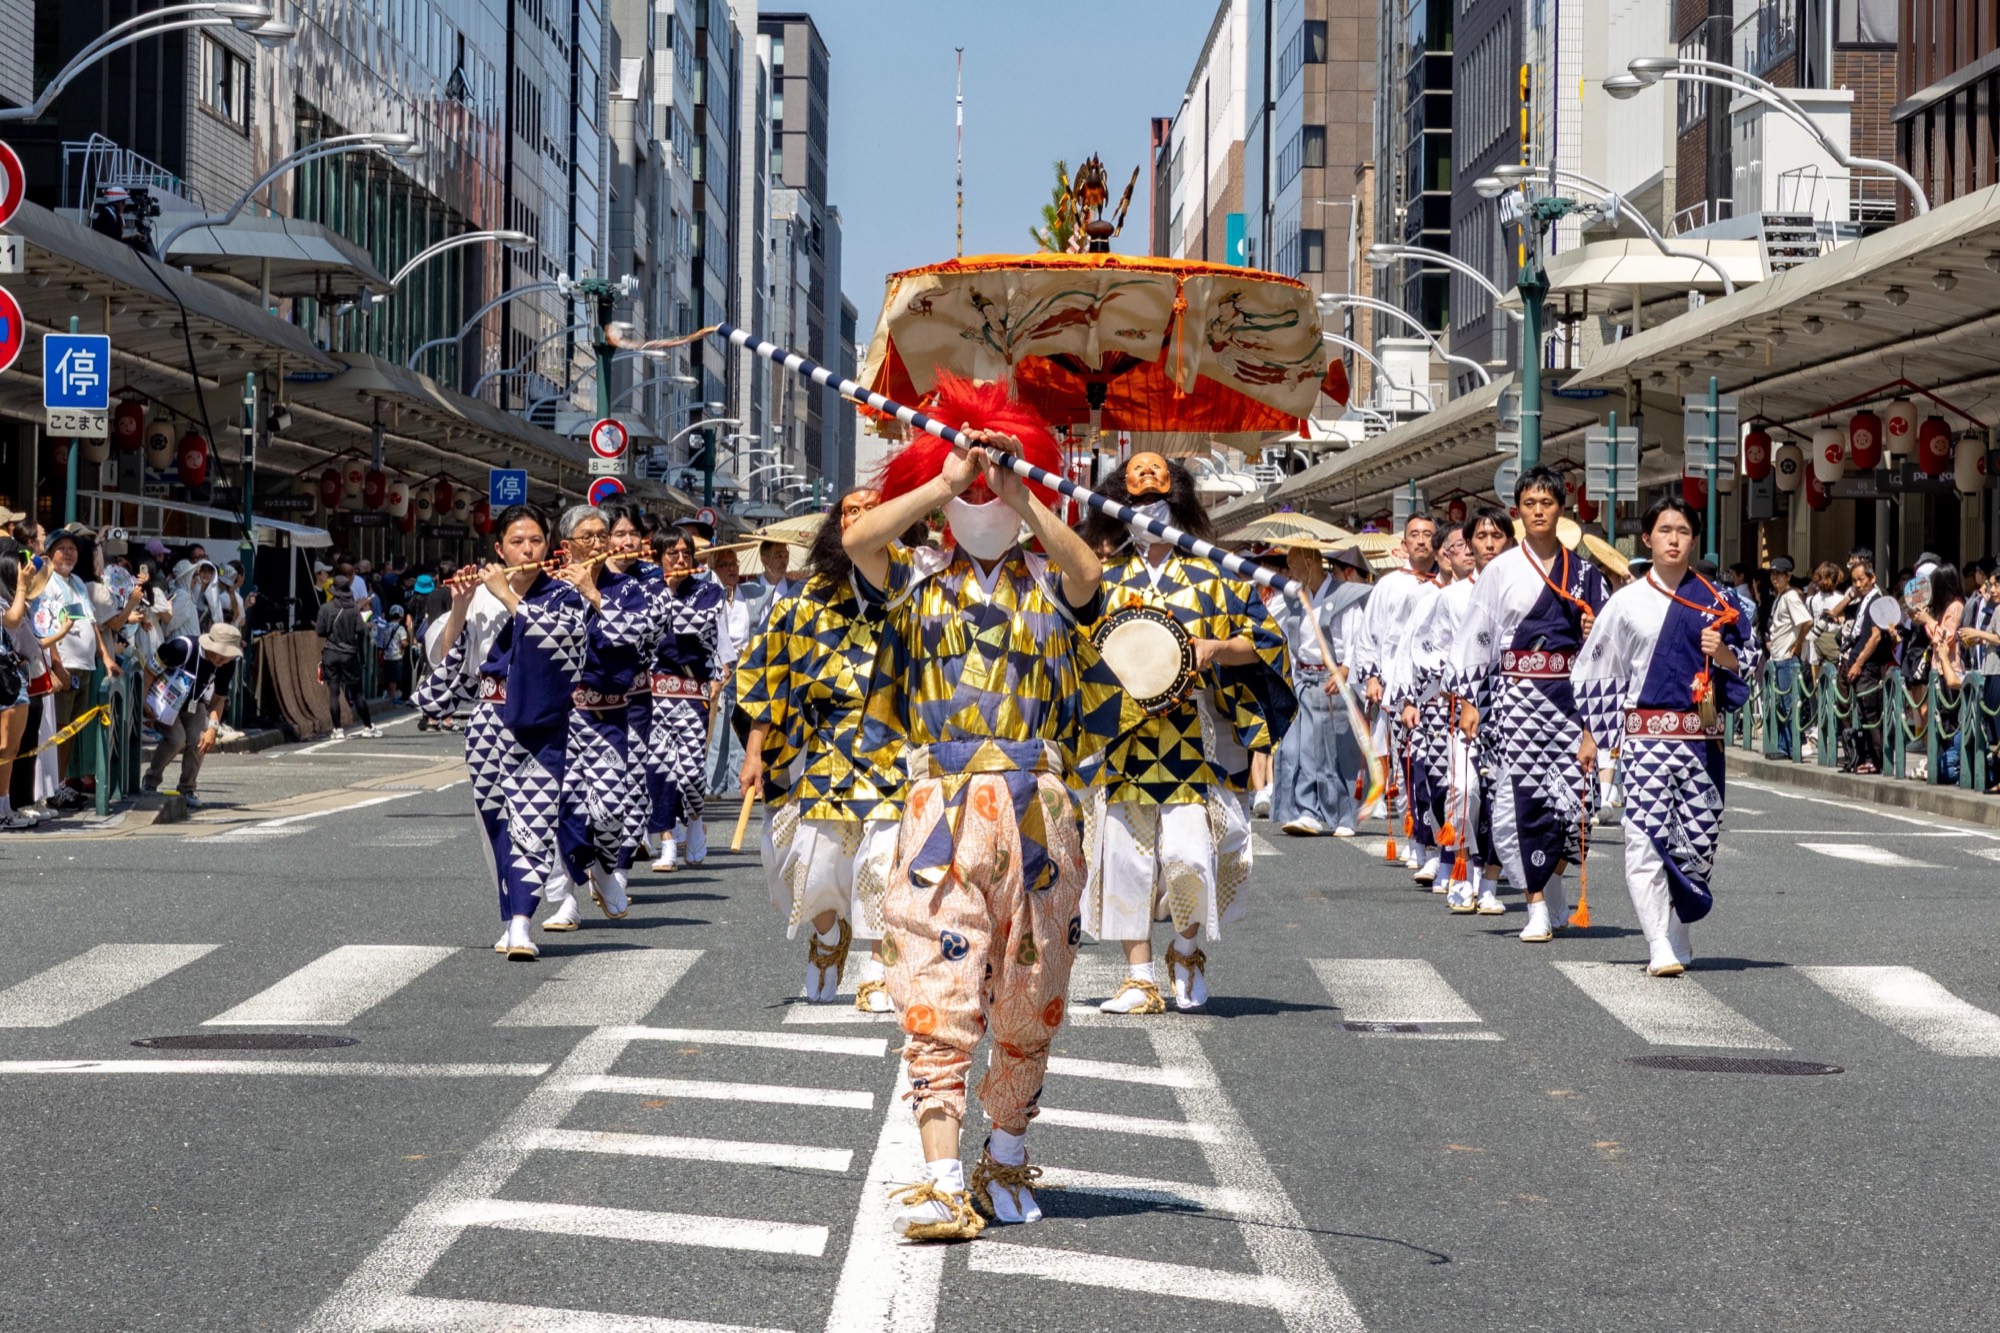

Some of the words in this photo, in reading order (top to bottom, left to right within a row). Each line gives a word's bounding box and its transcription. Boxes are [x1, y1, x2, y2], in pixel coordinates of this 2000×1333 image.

[0, 244, 16, 265] 1
[55, 347, 99, 396] 停
[50, 414, 104, 431] ここまで
[496, 475, 521, 500] 停
